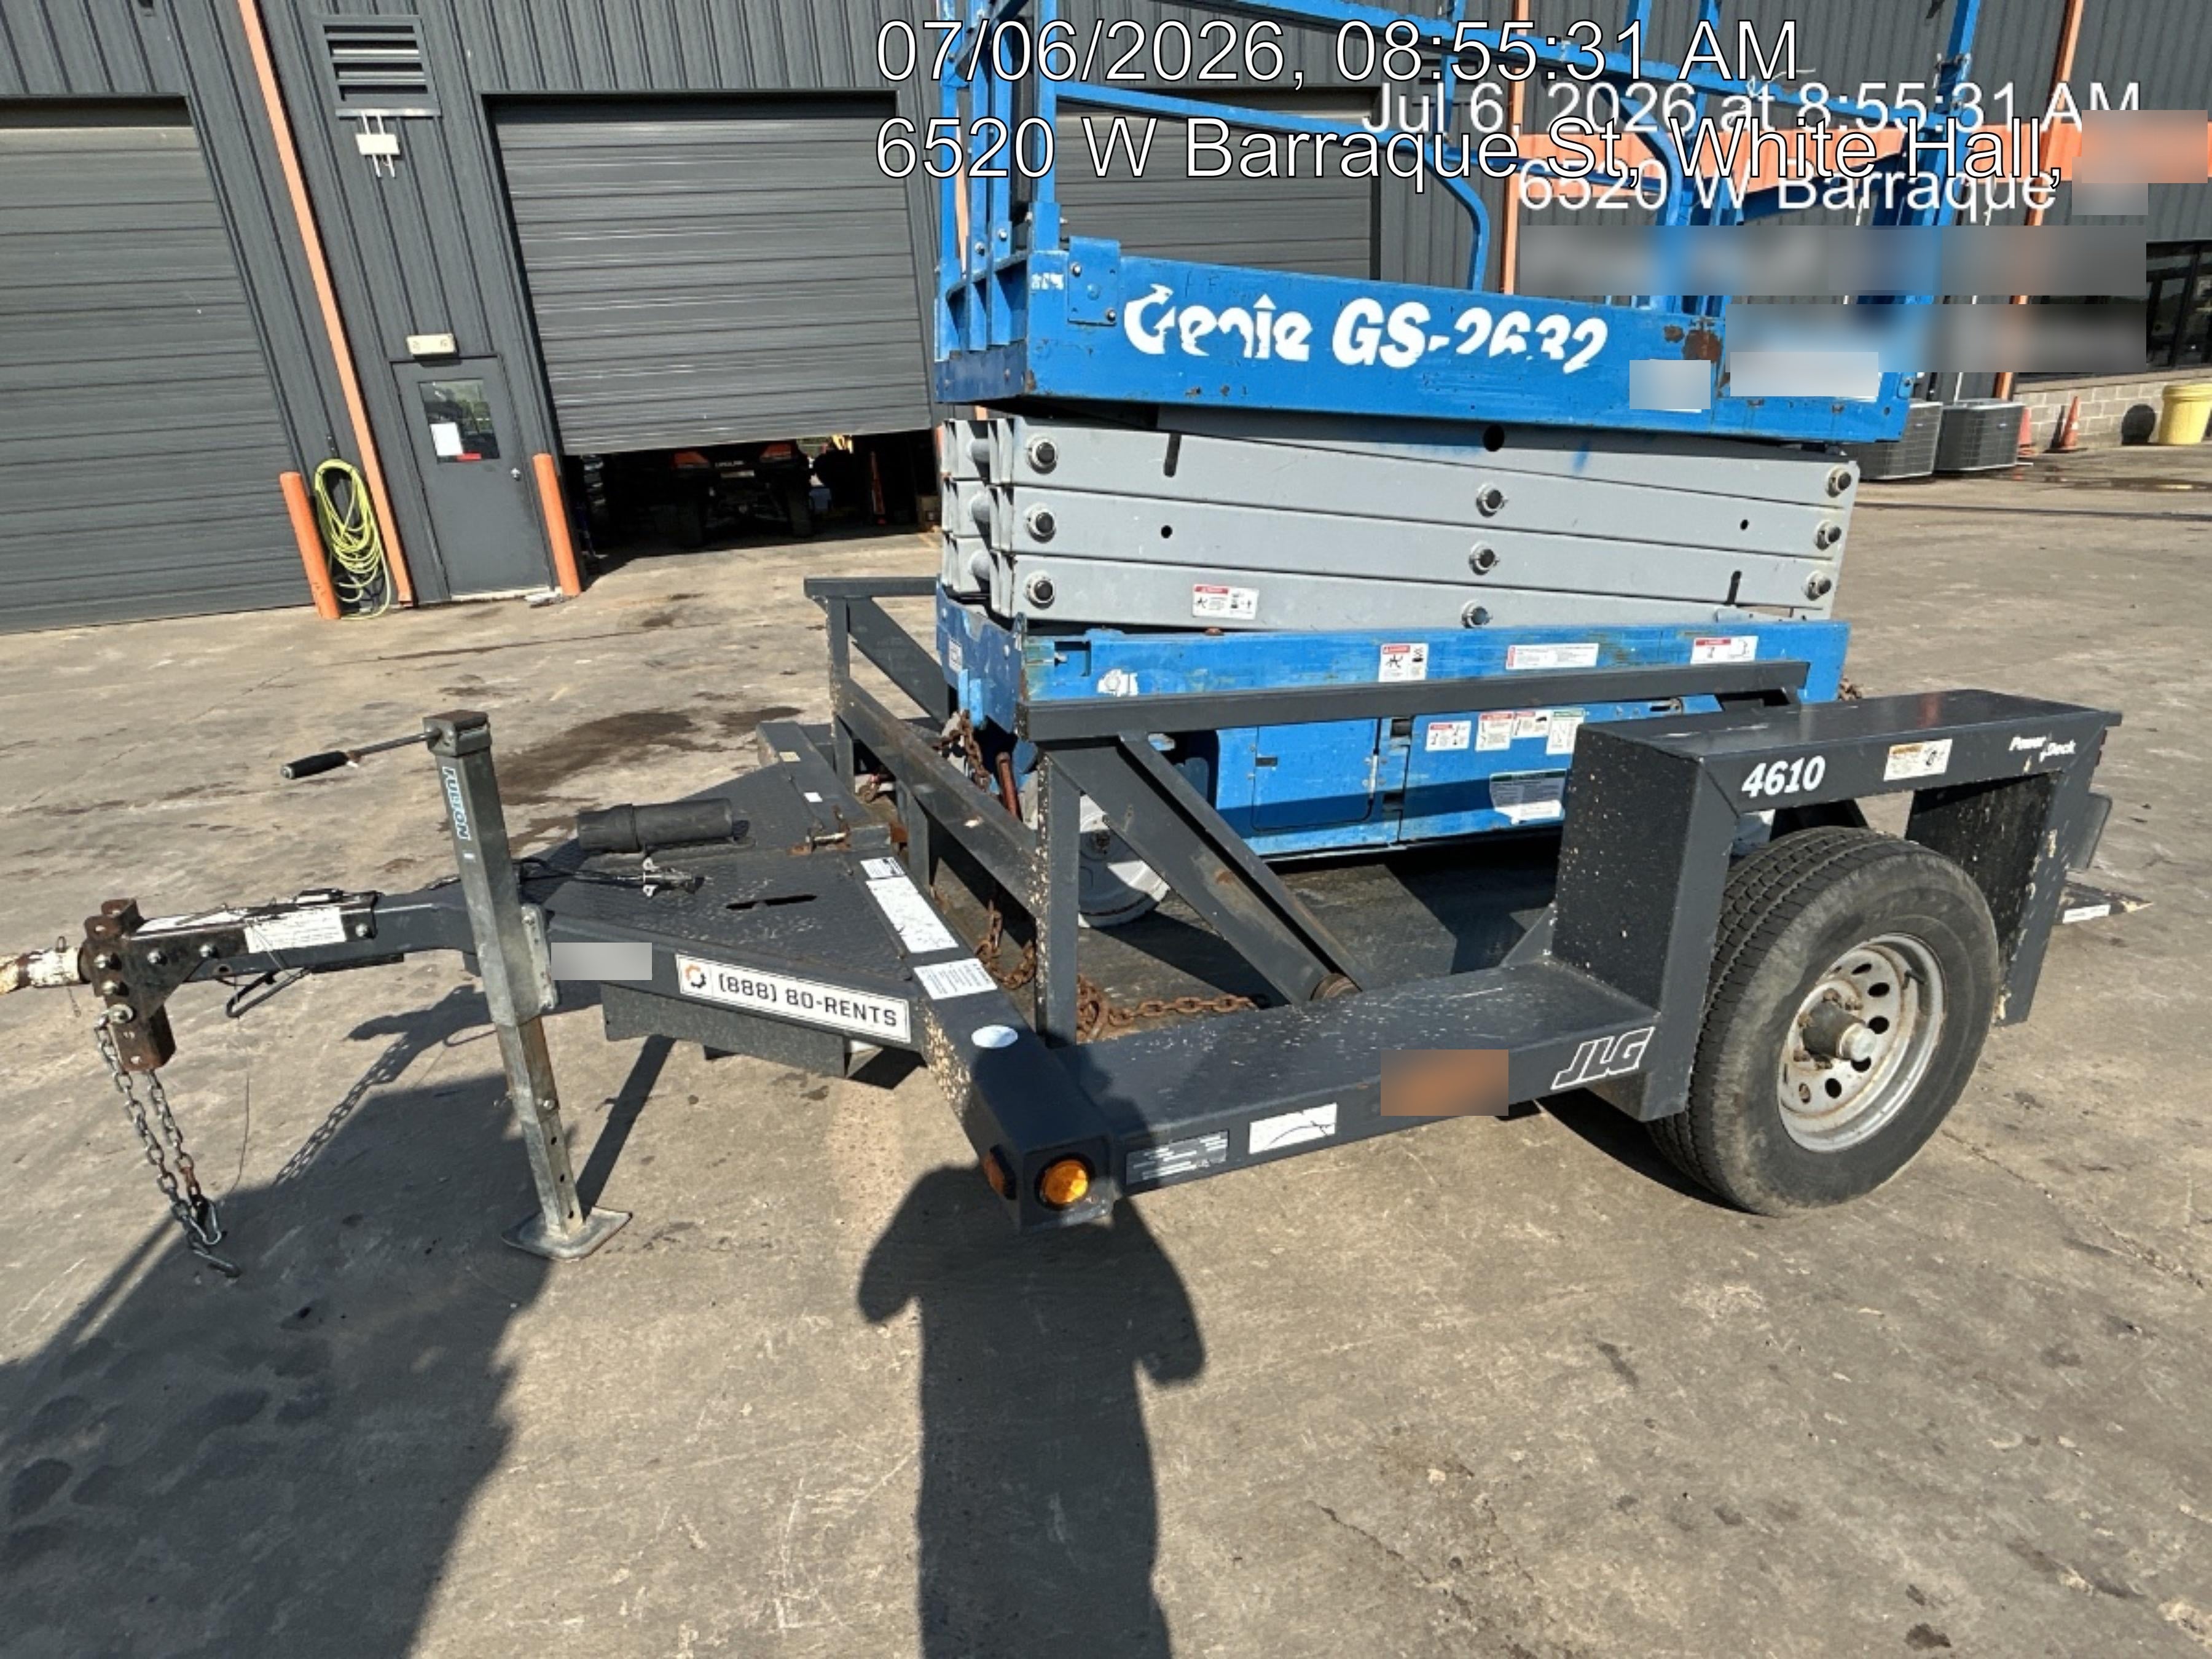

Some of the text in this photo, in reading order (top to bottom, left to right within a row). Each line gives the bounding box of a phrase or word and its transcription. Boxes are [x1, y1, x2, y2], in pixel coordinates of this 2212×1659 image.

[1124, 283, 1313, 361] Genie
[442, 766, 472, 841] FULTON
[1741, 755, 1826, 799] 4610
[718, 973, 897, 1027] (888) 80-RENTS
[1550, 1026, 1657, 1091] JLG
